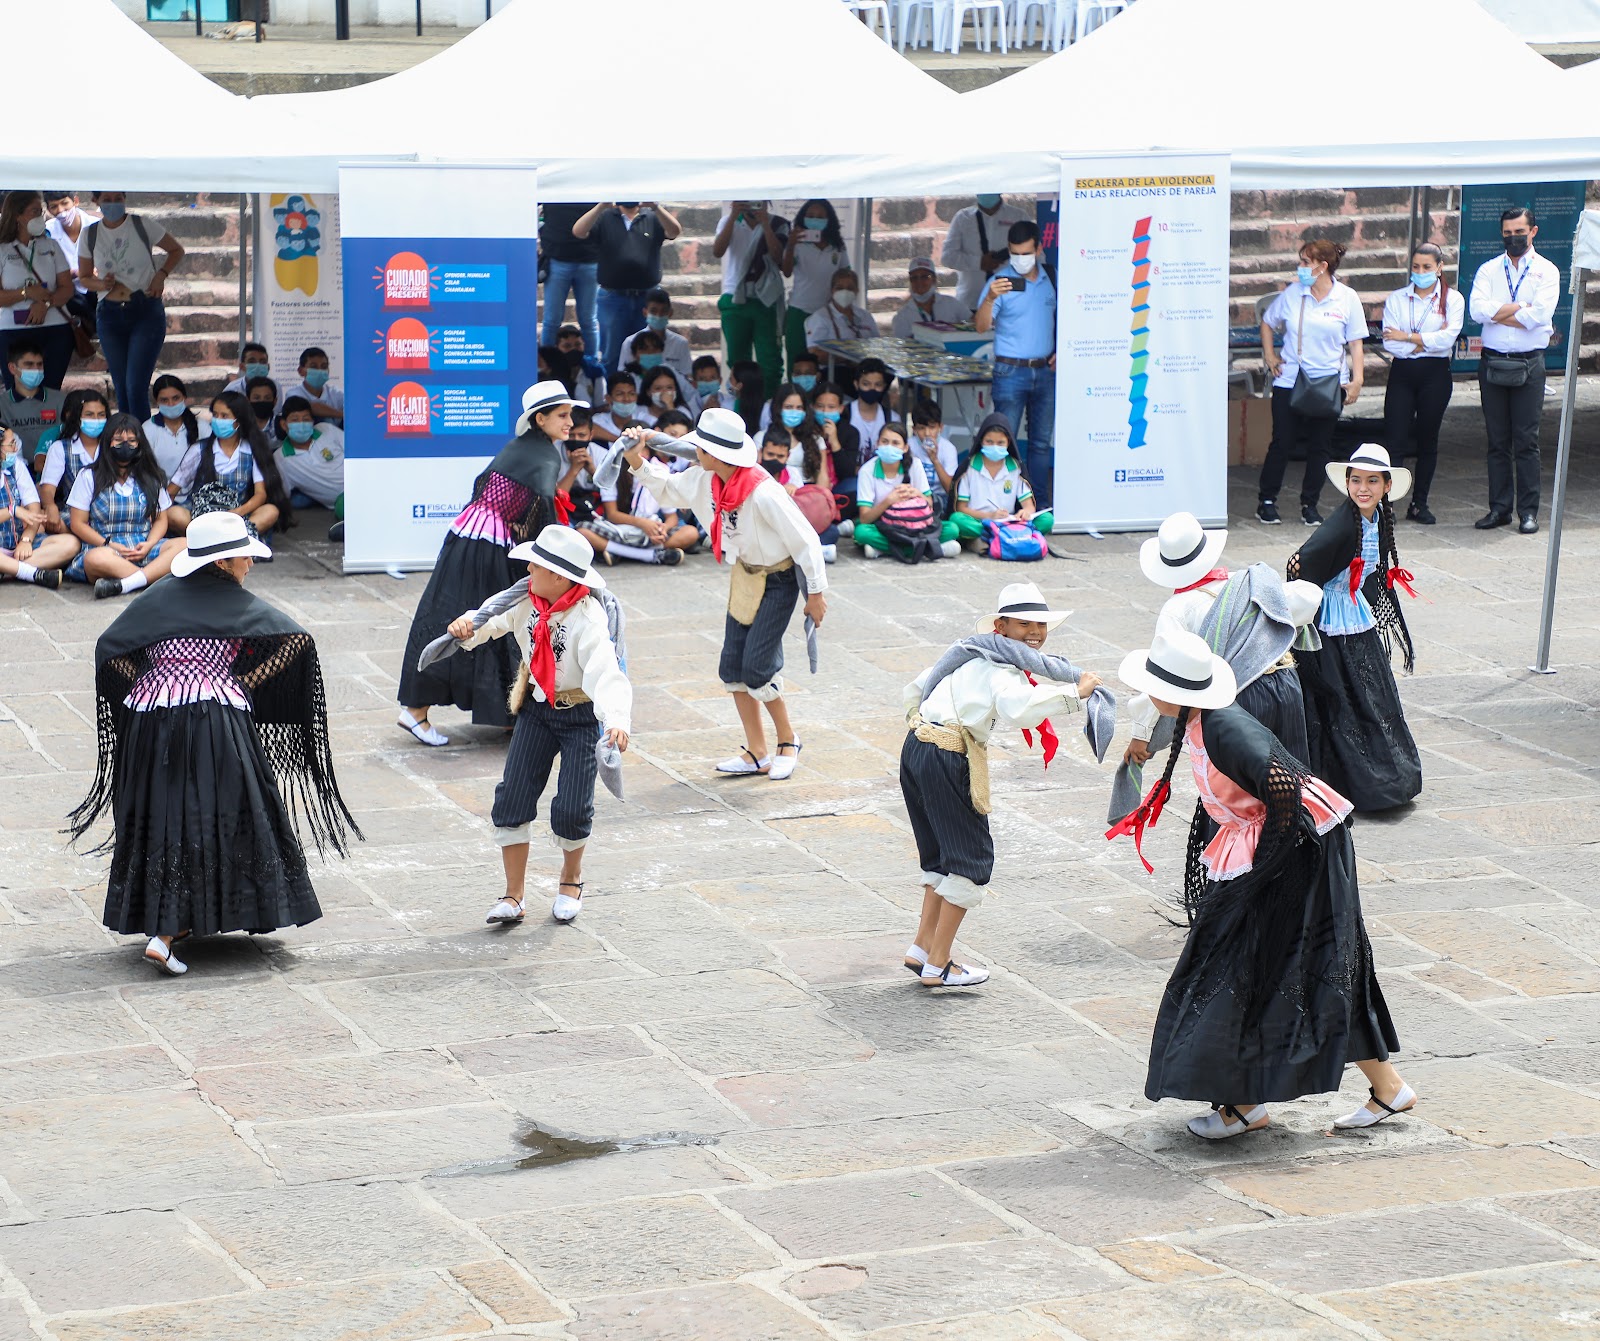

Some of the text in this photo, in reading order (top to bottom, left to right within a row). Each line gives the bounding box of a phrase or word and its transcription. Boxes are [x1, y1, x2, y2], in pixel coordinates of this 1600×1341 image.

[1076, 176, 1212, 188] ESCALERA DE LA VIOLENCIA
[1075, 186, 1216, 198] EN LAS RELACIONES DE PAREJA
[386, 269, 428, 286] CUIDADO
[387, 291, 428, 299] PRESENTE
[388, 338, 429, 352] REACCIONA
[390, 394, 427, 414] ALÉJATE
